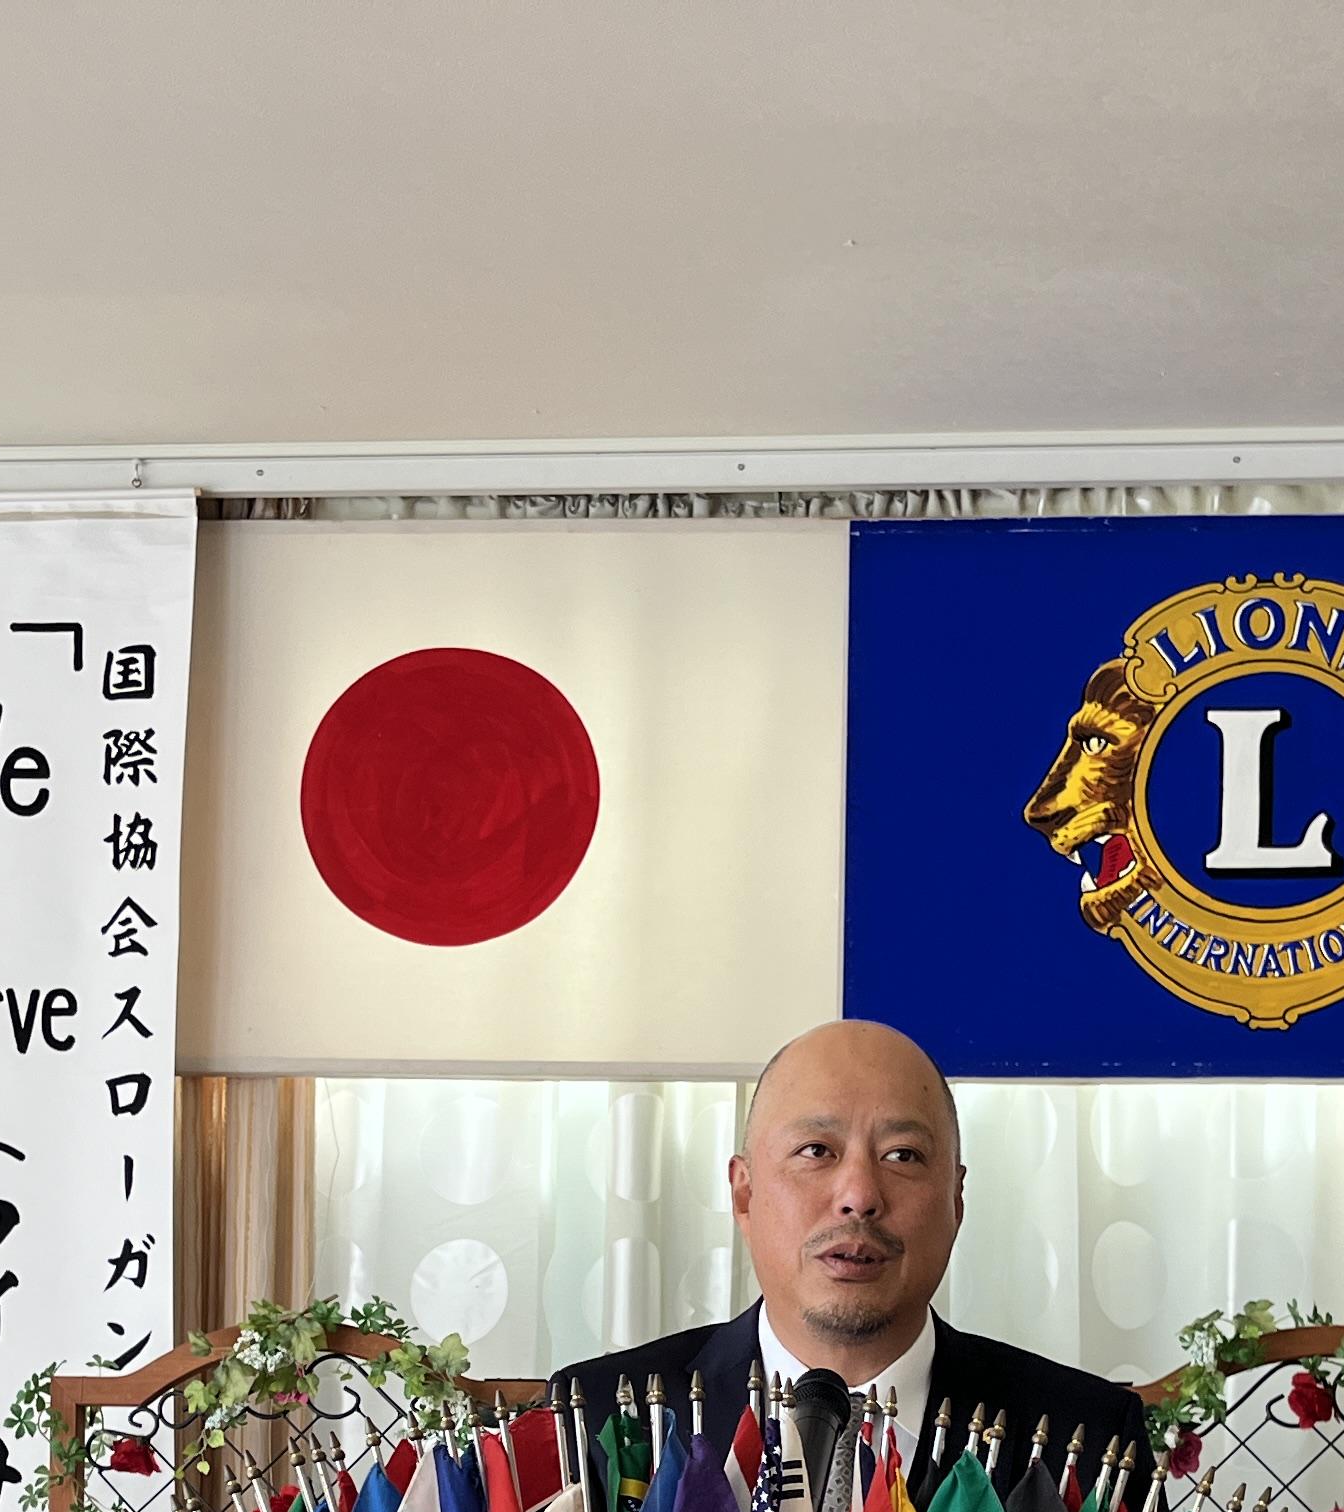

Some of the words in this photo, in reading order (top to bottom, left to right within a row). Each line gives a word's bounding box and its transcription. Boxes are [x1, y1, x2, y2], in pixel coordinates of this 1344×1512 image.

[101, 644, 159, 1369] 国際協会スローガン
[1204, 708, 1344, 877] L
